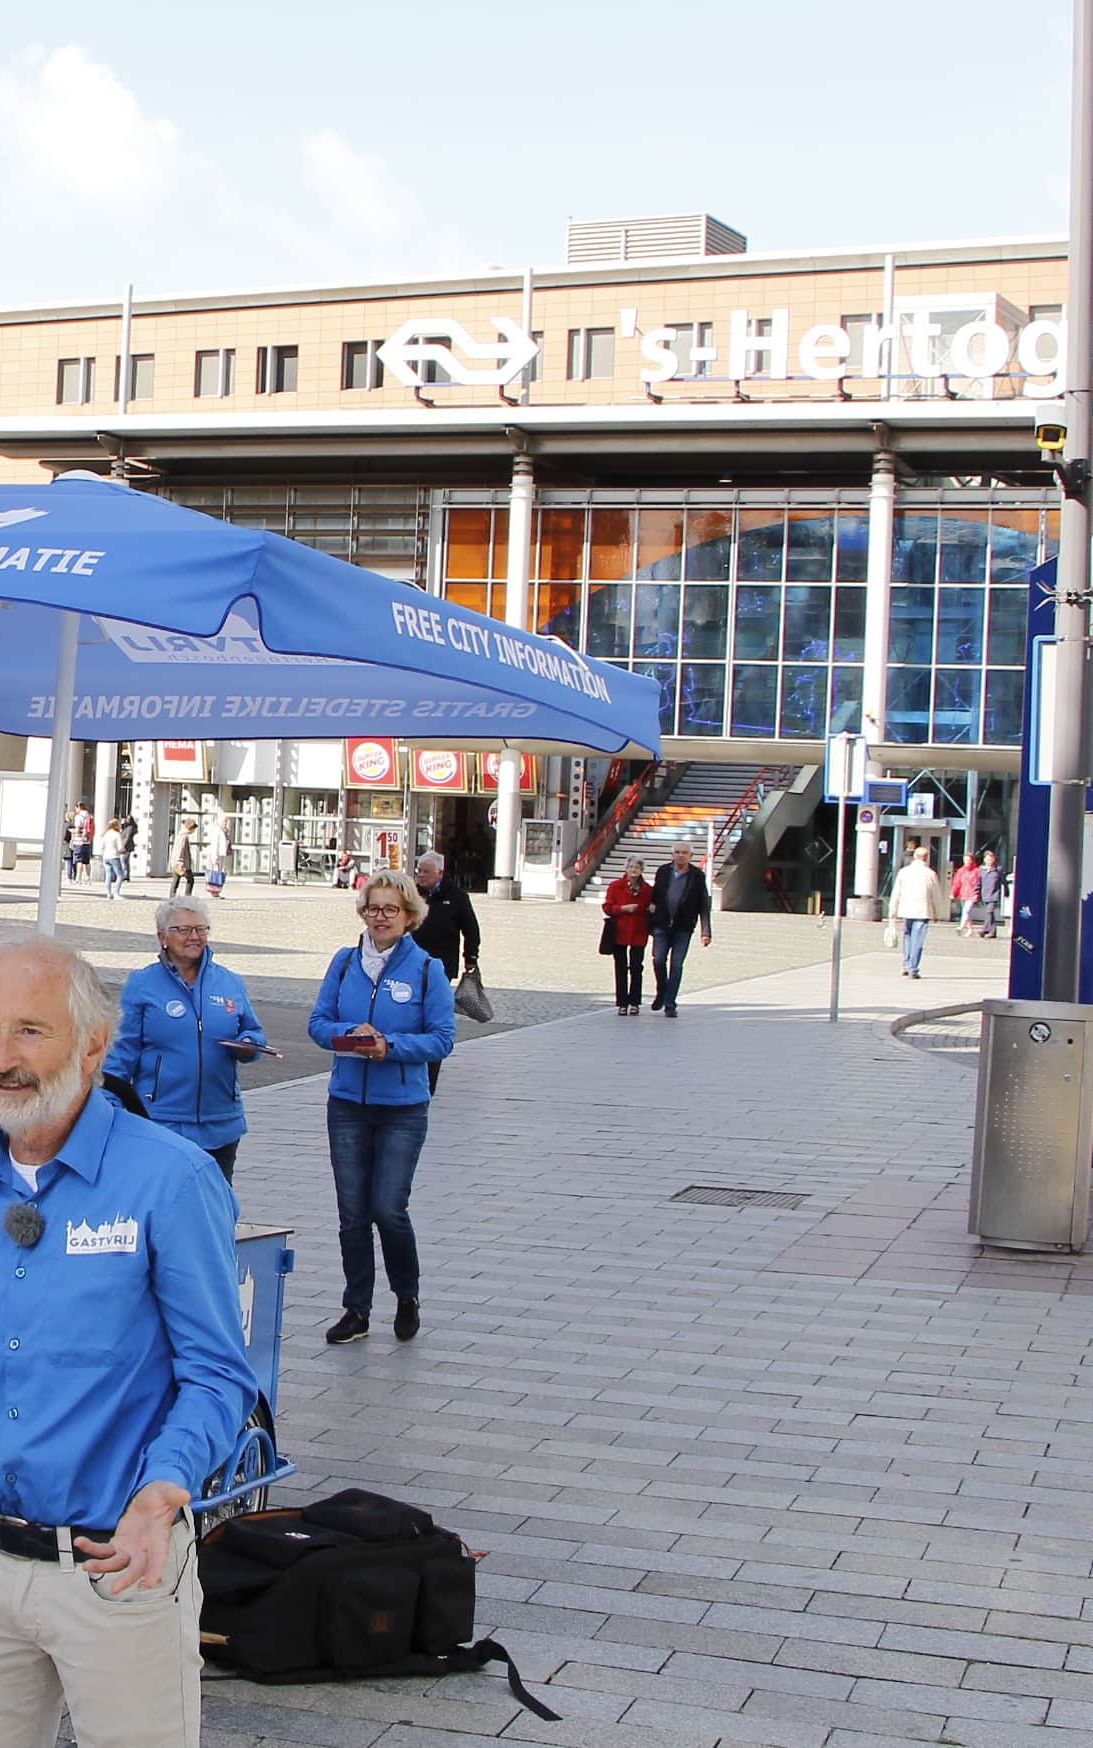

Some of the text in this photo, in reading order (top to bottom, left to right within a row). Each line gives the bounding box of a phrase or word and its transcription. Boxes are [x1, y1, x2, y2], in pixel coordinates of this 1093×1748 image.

[391, 602, 612, 704] FREE CITY INFORMATION
[69, 1234, 135, 1248] GASTVRIJ
